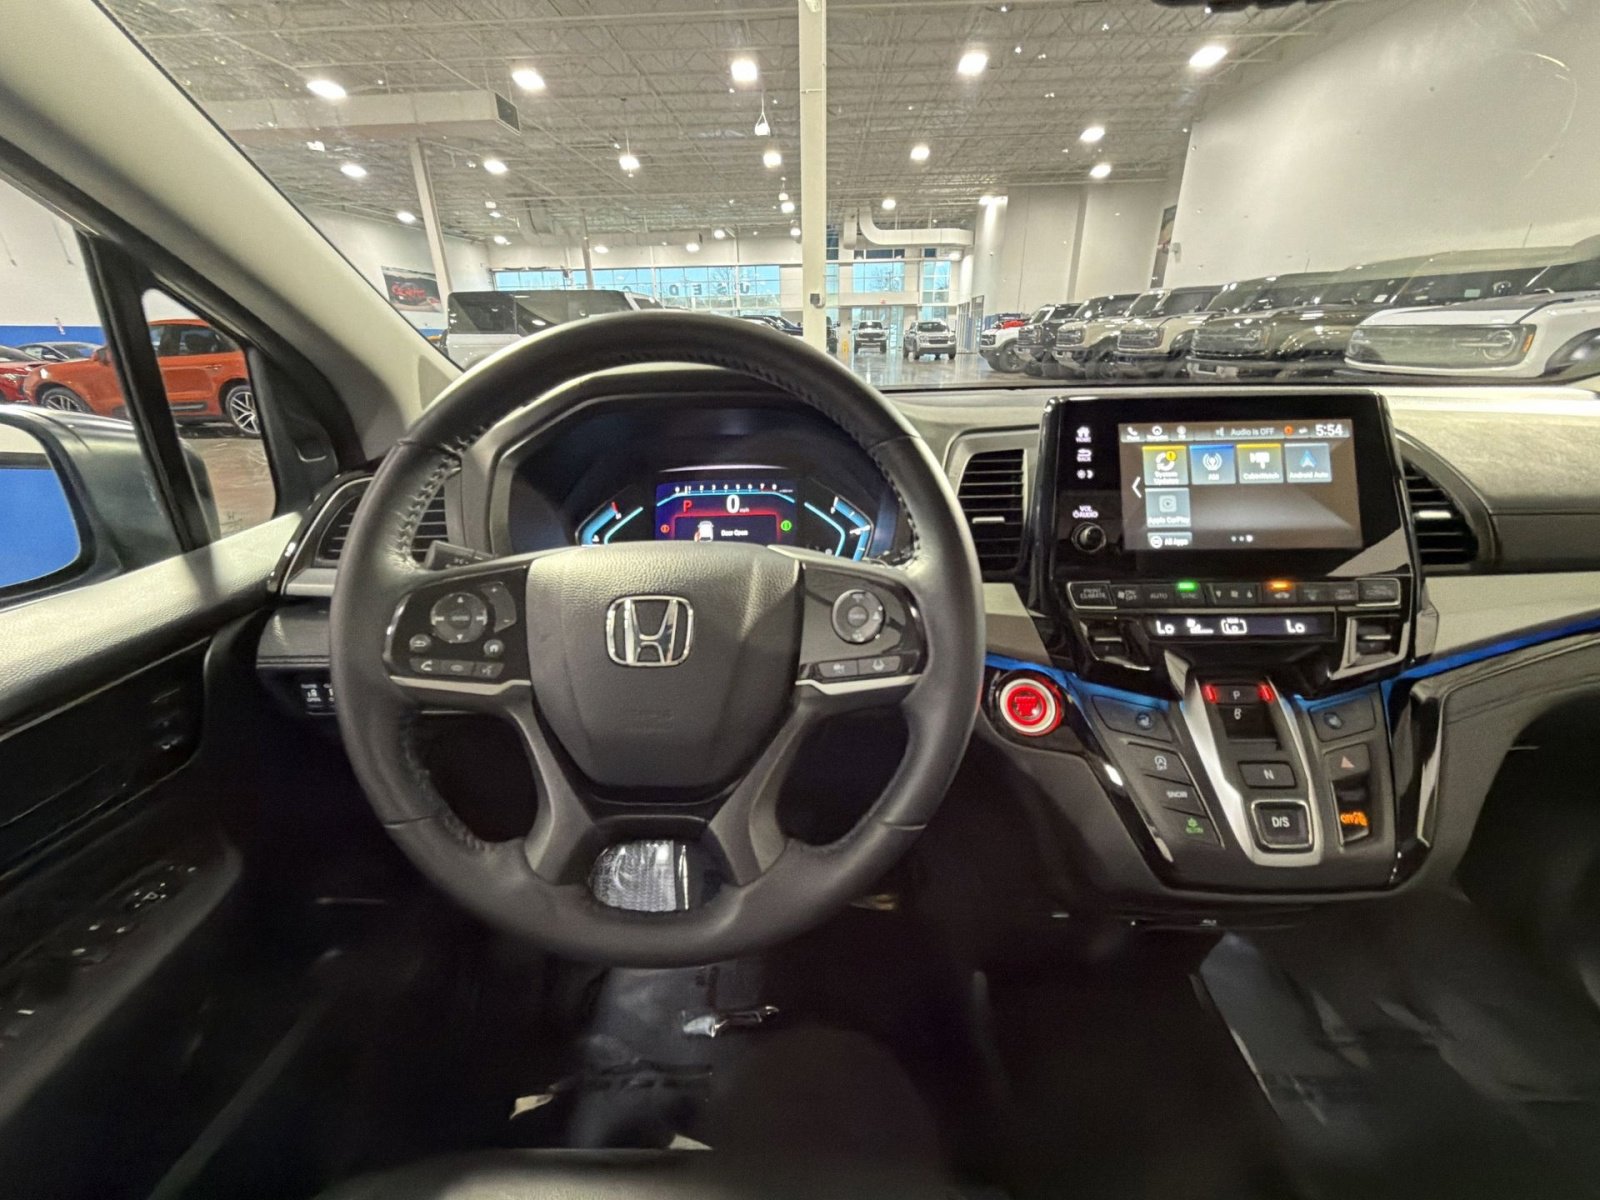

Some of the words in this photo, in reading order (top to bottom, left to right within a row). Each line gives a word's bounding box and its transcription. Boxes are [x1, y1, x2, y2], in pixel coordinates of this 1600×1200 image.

[1230, 428, 1251, 436] Audio
[1260, 427, 1276, 436] OFF
[1315, 423, 1343, 437] 5:54
[1289, 471, 1313, 479] Android
[1314, 471, 1329, 479] Auto
[683, 499, 693, 512] P
[726, 494, 740, 513] 0
[720, 529, 734, 537] Door
[734, 529, 749, 538] Open
[1150, 592, 1168, 600] AUTO
[1181, 592, 1198, 600] SYNC
[1155, 619, 1175, 635] Lo
[1285, 618, 1307, 634] Lo
[1233, 690, 1241, 701] P
[1263, 768, 1275, 781] N
[1166, 790, 1189, 799] SNOW
[1271, 815, 1291, 829] D/S
